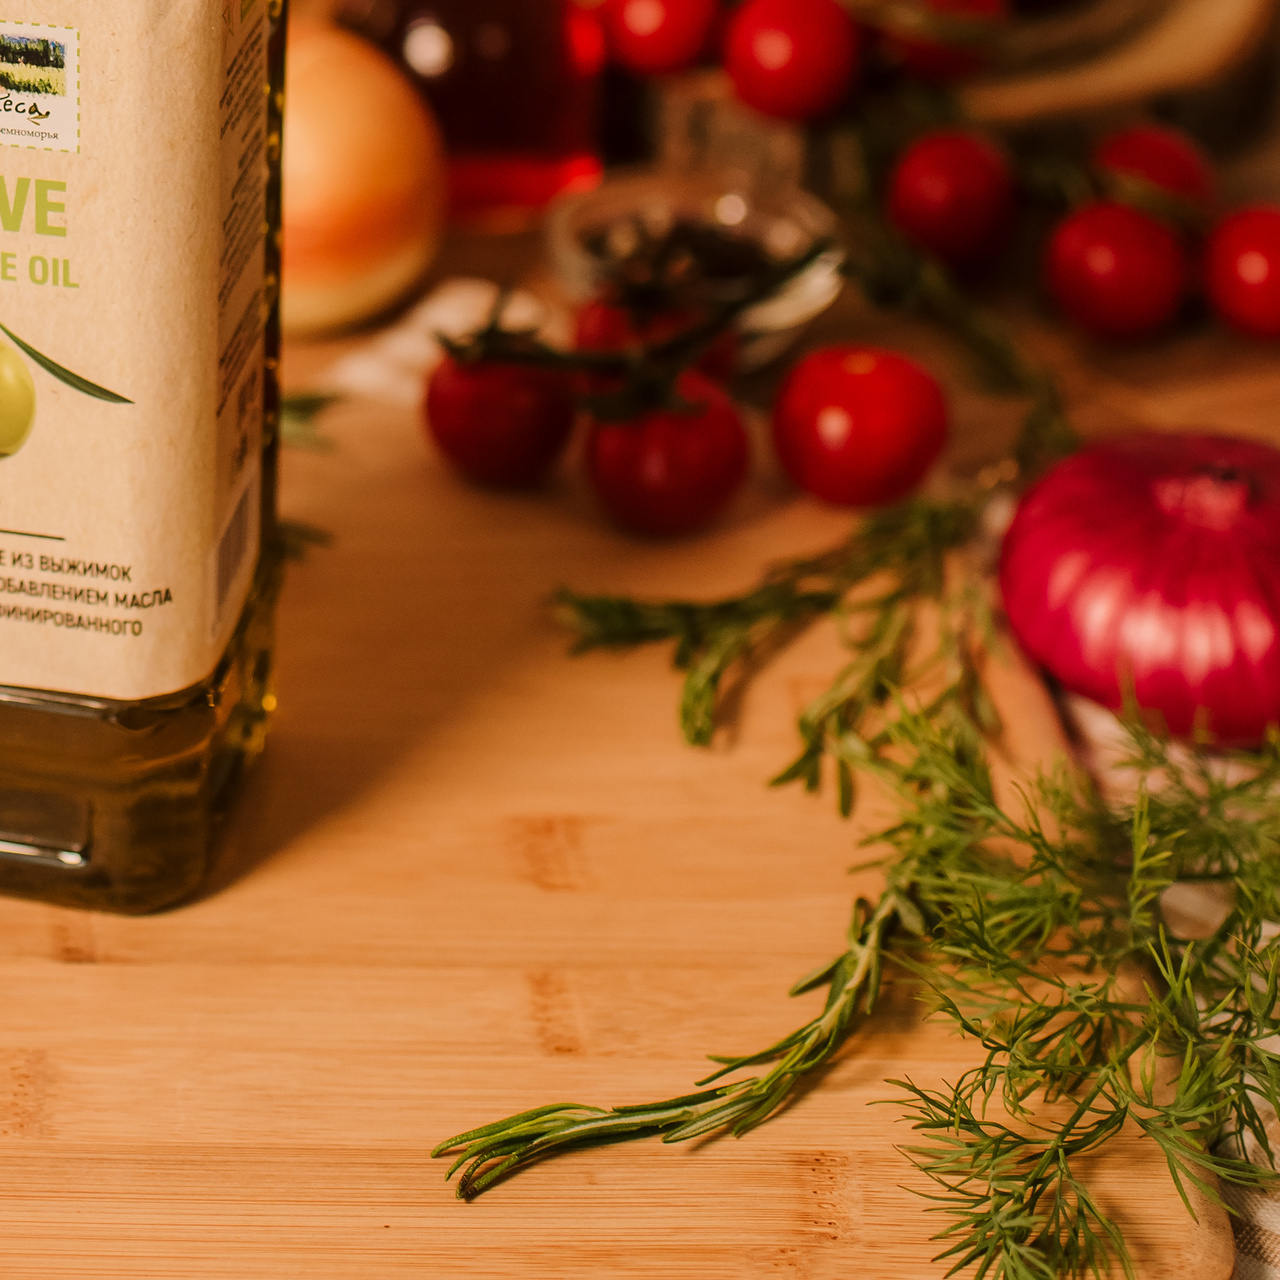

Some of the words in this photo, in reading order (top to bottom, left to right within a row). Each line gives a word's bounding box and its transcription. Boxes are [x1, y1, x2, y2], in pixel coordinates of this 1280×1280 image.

[29, 255, 80, 288] OIL
[12, 552, 34, 570] ИЗ
[40, 555, 132, 582] ВЫЖИМОК
[115, 588, 173, 609] МАСЛА
